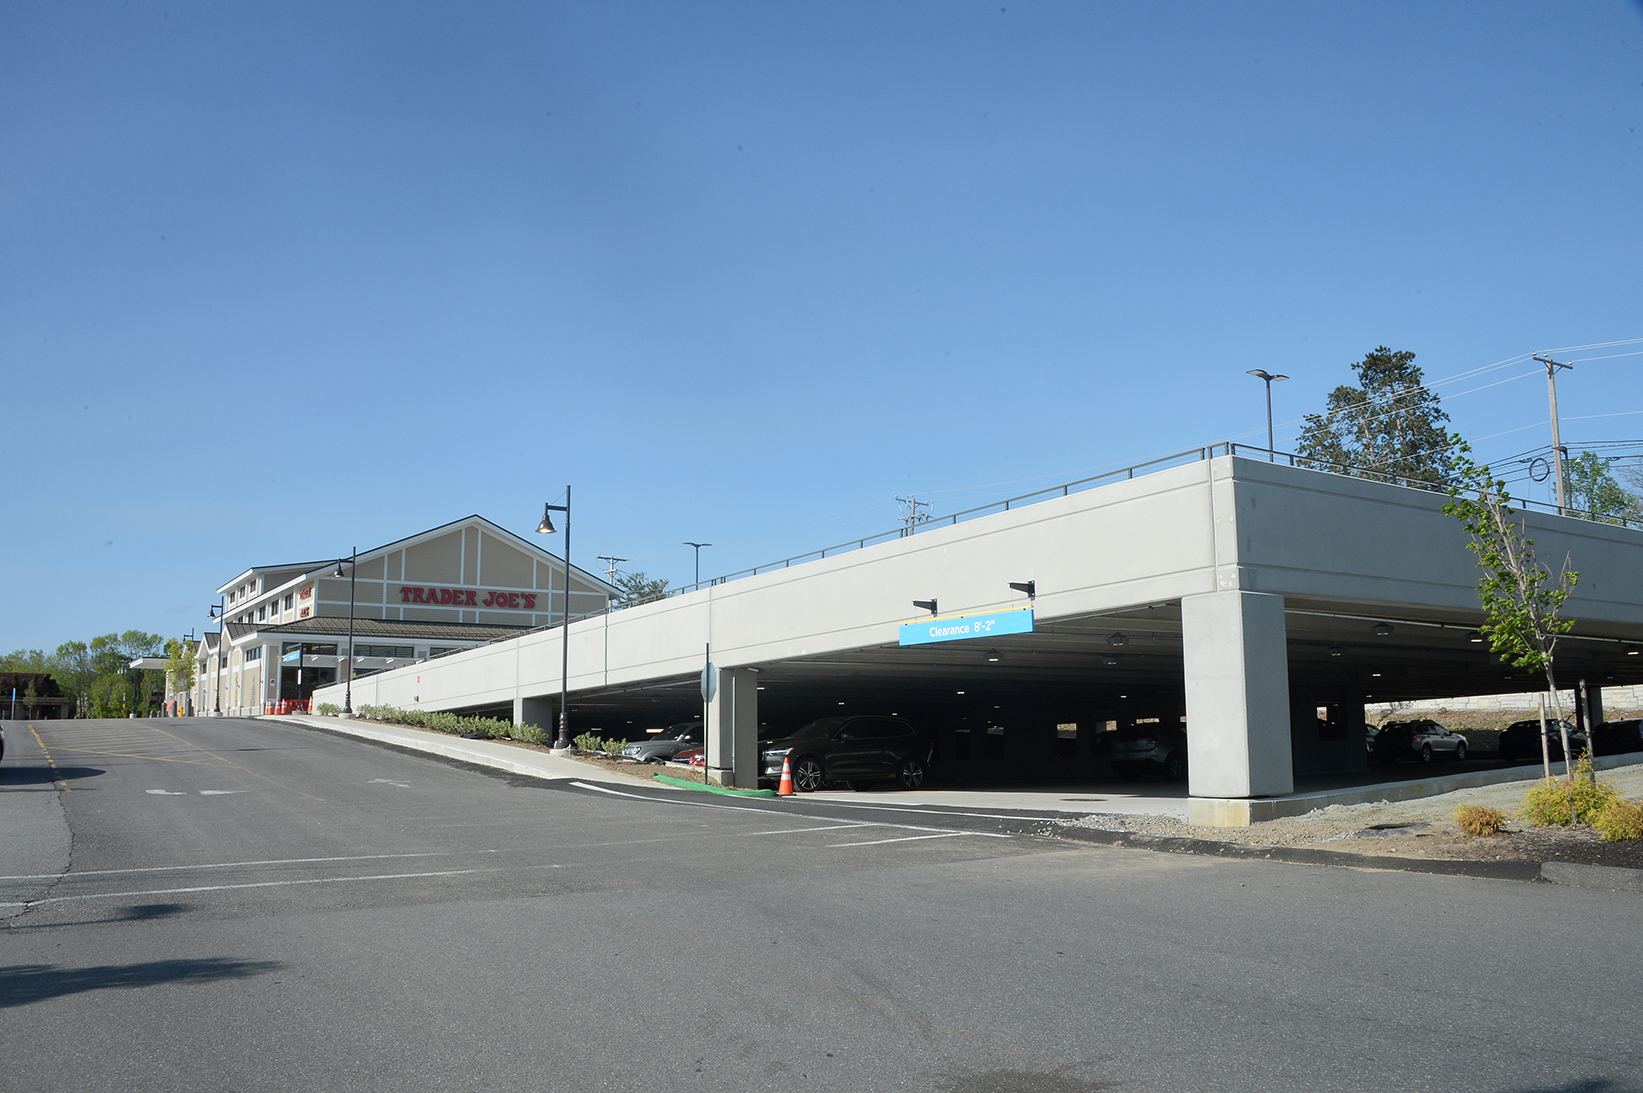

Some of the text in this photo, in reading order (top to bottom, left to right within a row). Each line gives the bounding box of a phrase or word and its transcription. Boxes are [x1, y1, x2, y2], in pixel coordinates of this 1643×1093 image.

[400, 587, 537, 609] TRADER JOE'S
[929, 625, 970, 637] Clearance
